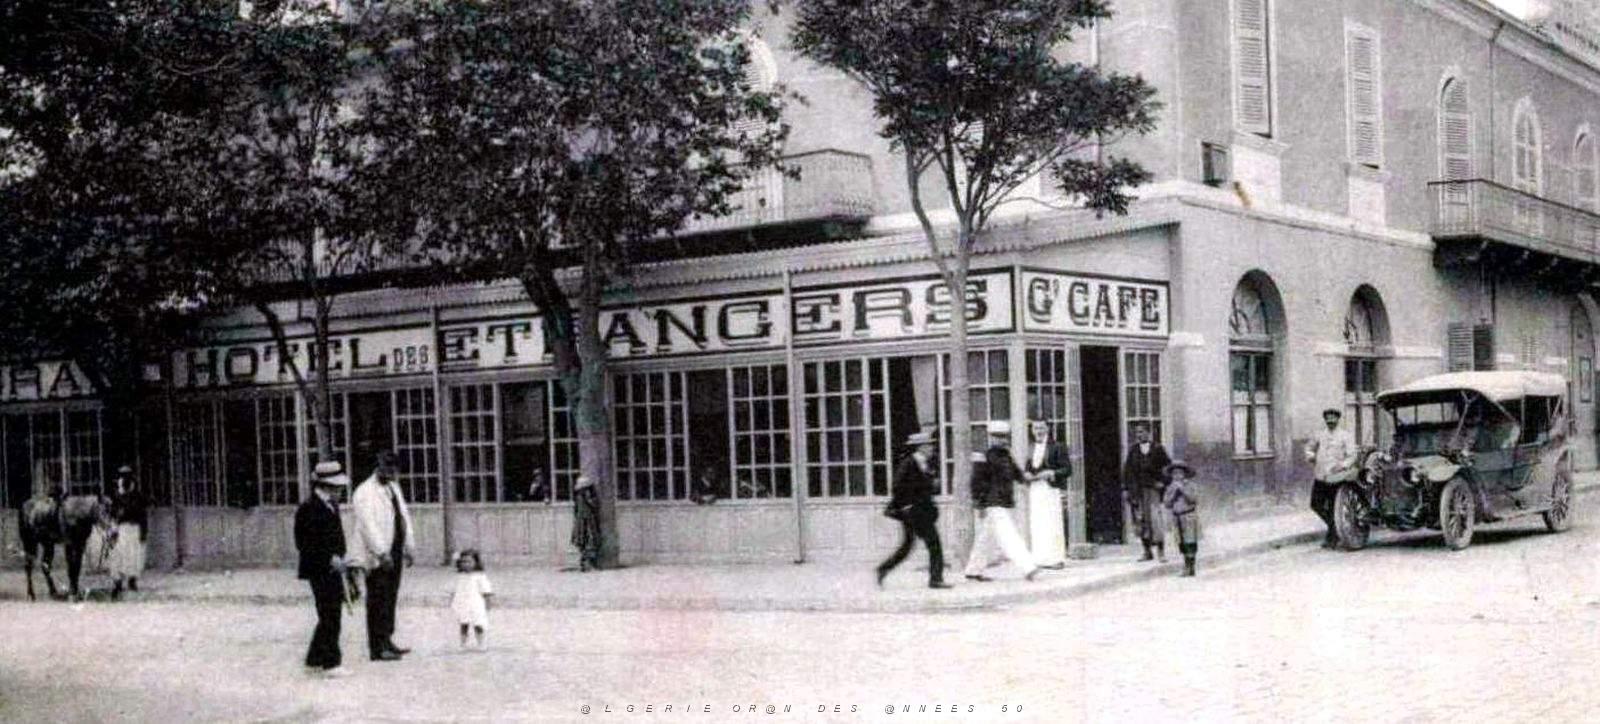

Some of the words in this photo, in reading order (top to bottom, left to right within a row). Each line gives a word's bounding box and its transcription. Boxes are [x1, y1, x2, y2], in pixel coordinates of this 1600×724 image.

[186, 337, 387, 388] HOTEL
[393, 345, 429, 373] DES
[437, 280, 988, 370] ETANGERS
[1068, 281, 1159, 331] CAFE
